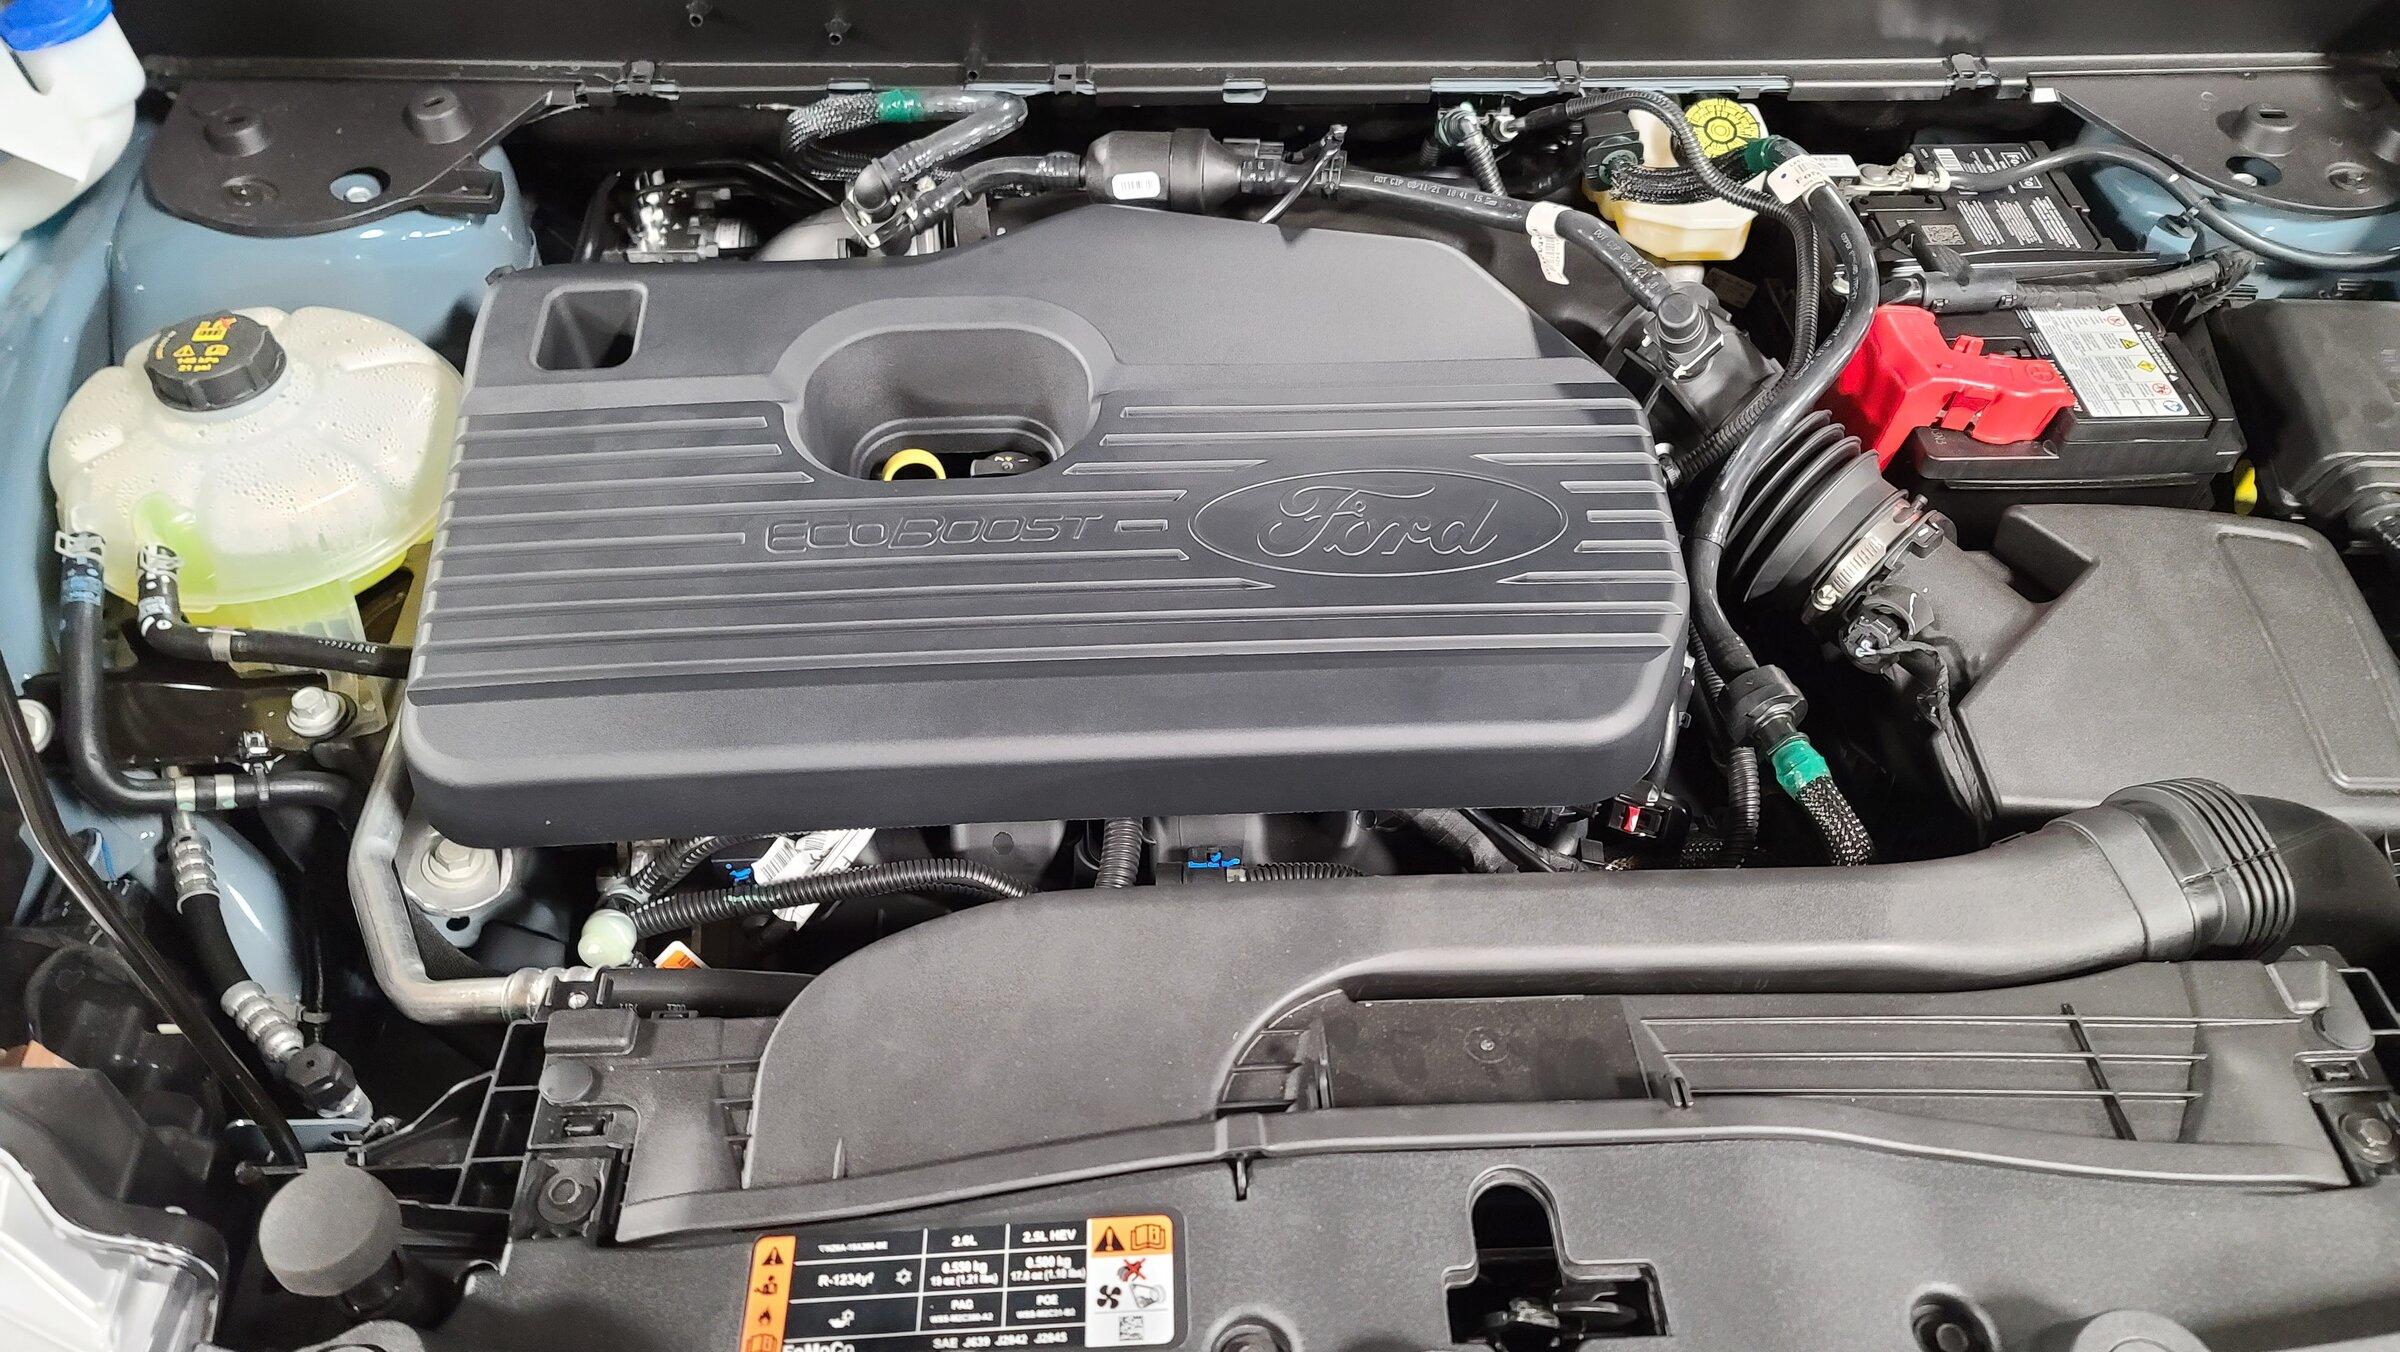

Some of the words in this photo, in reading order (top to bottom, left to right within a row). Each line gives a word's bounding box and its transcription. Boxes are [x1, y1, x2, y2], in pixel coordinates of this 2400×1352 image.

[1256, 485, 1498, 556] Ford
[1049, 1228, 1077, 1241] HEV
[932, 1337, 959, 1350] SAE
